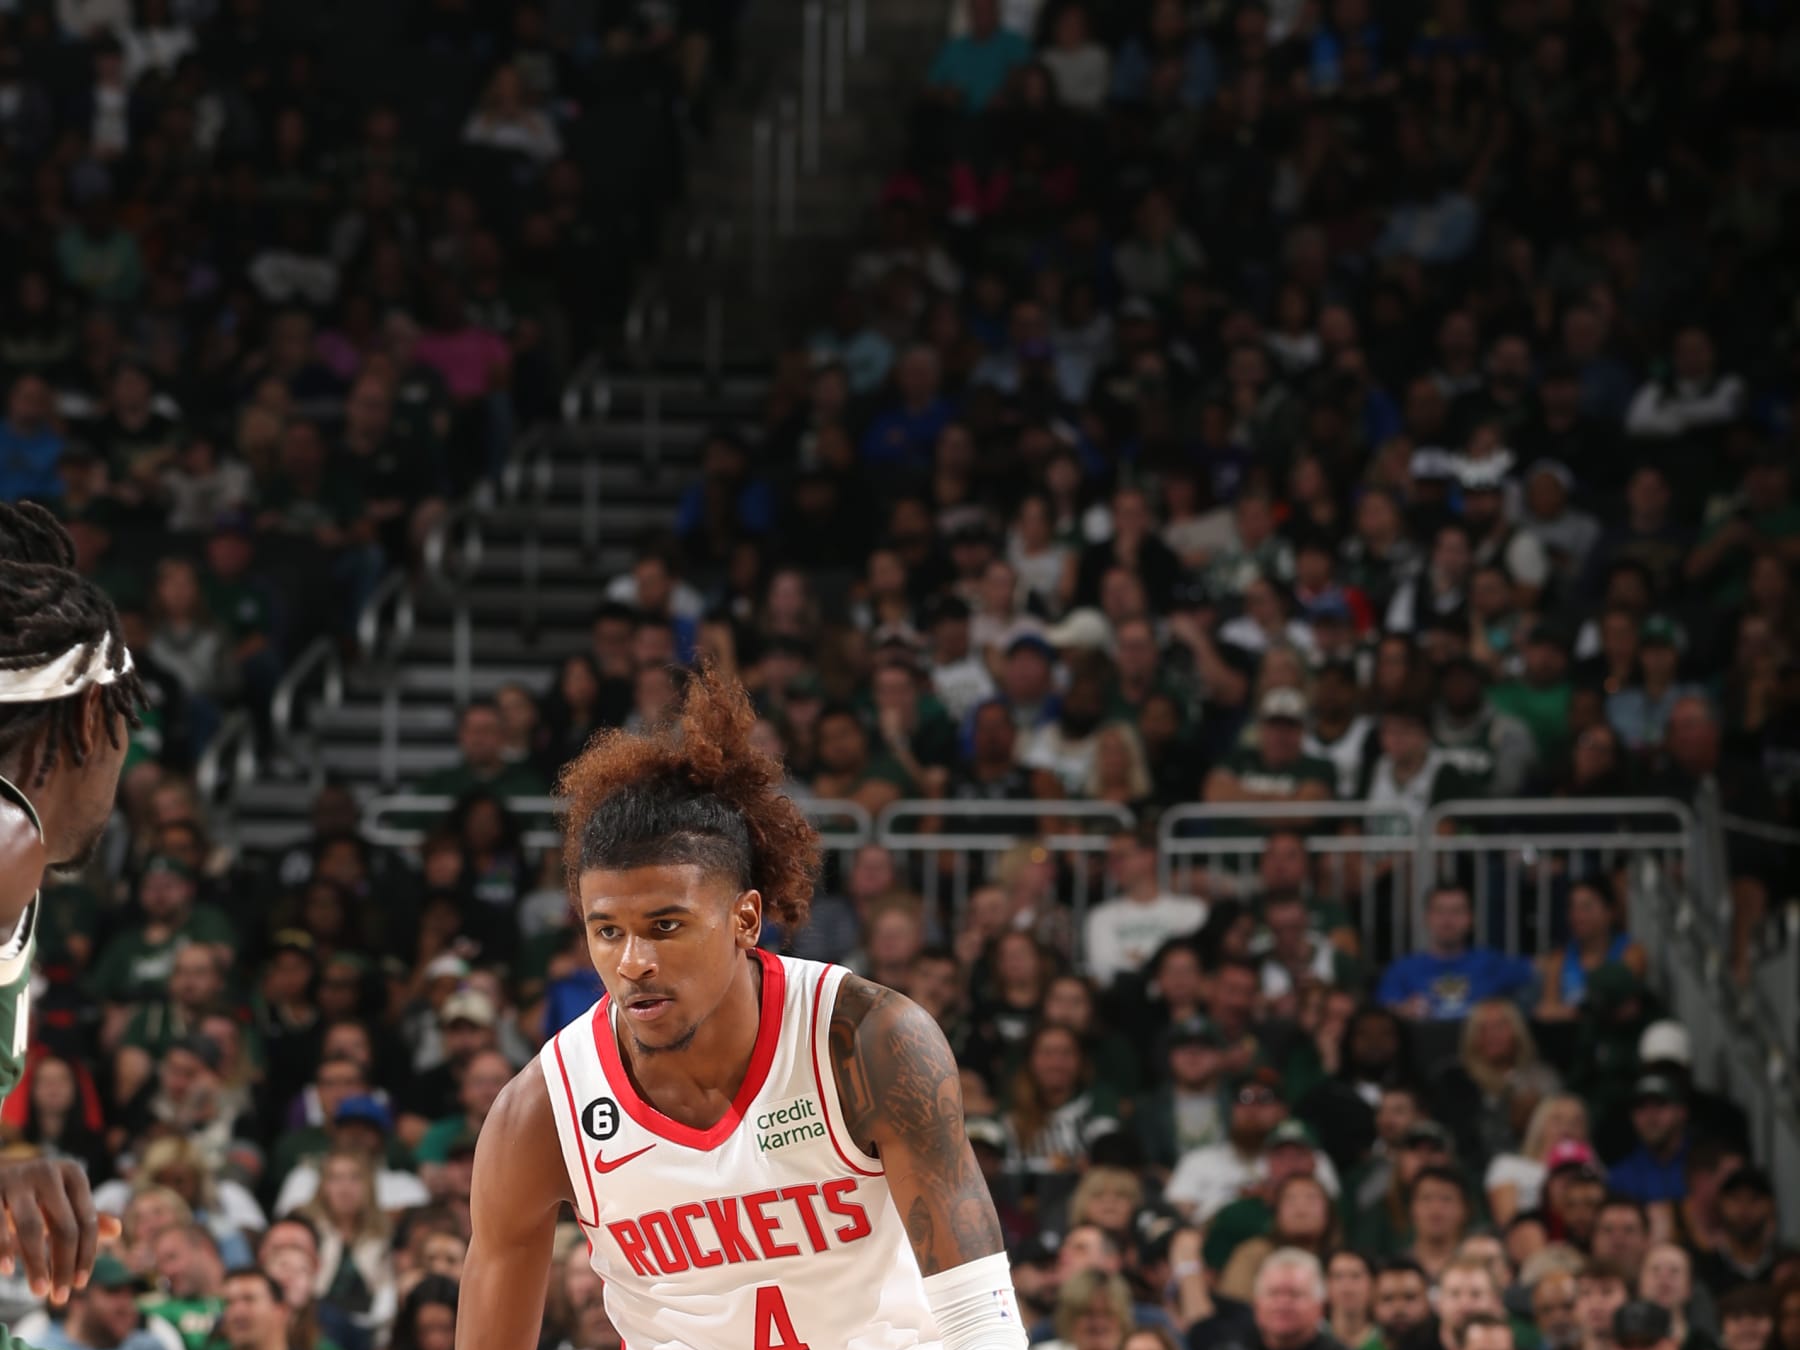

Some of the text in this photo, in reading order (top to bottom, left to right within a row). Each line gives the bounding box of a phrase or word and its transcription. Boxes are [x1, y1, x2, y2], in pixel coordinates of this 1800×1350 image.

[593, 1103, 613, 1135] 6
[757, 1099, 816, 1129] credit
[757, 1121, 826, 1152] karma
[607, 1178, 872, 1276] ROCKETS
